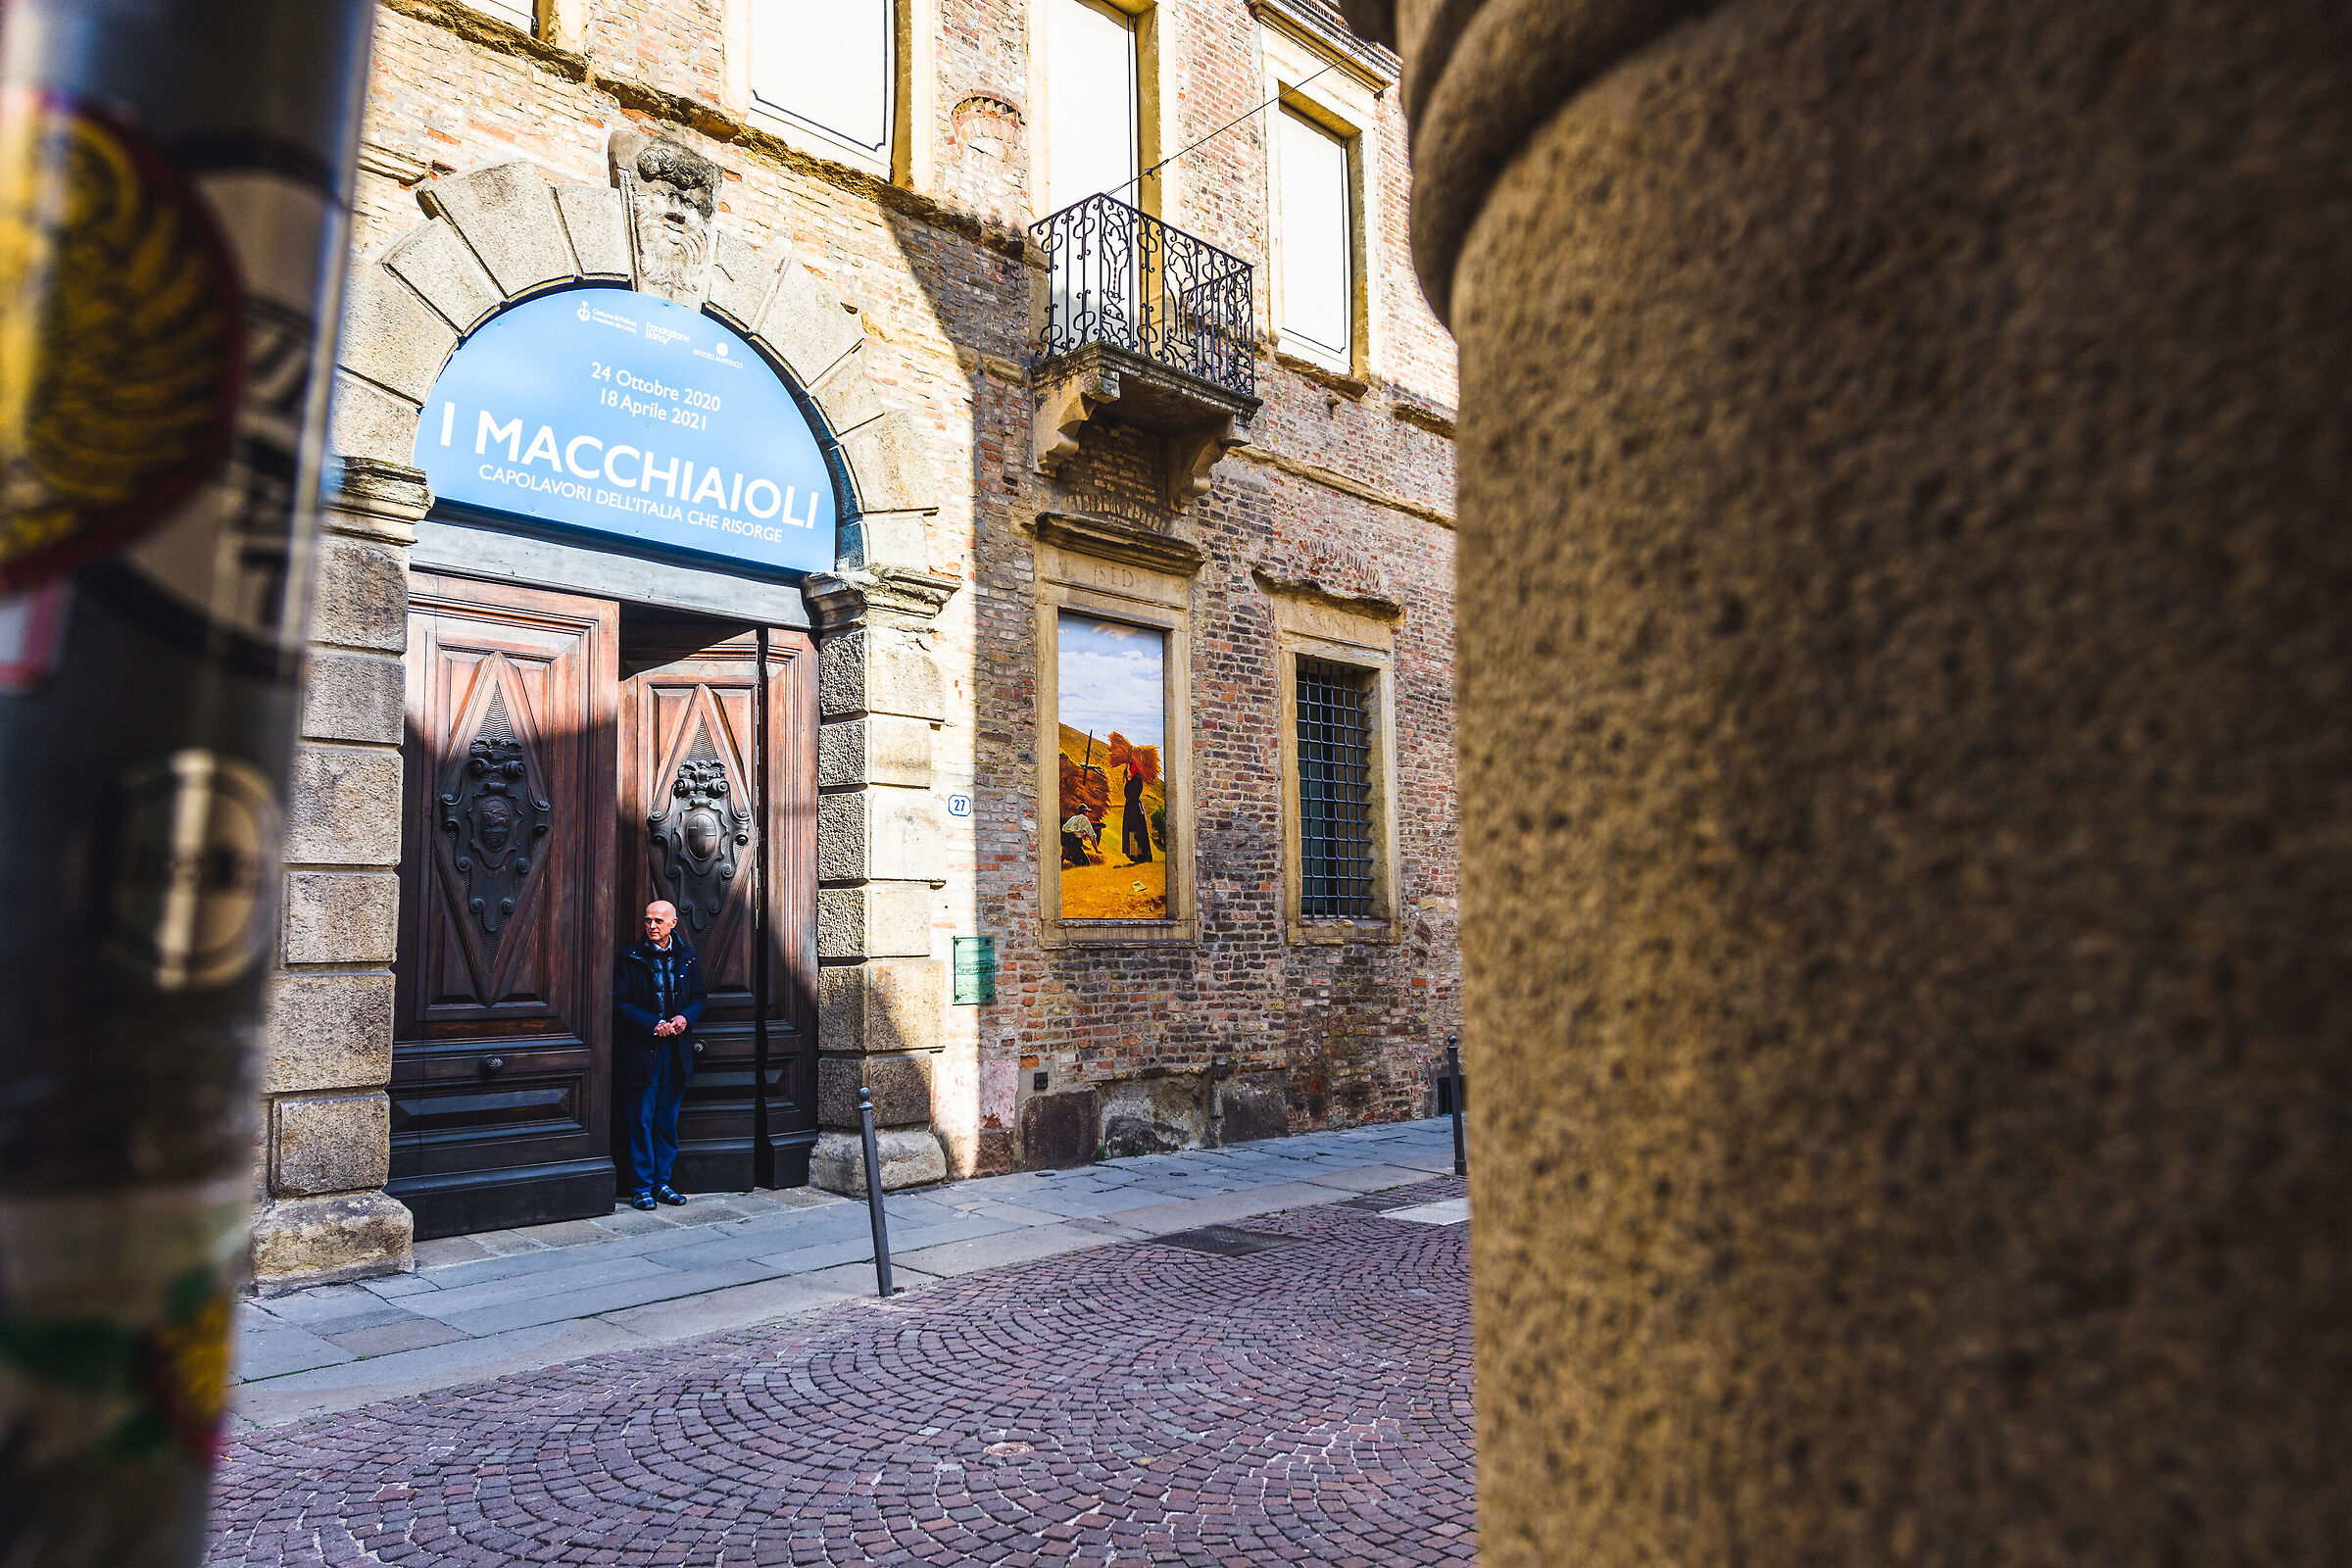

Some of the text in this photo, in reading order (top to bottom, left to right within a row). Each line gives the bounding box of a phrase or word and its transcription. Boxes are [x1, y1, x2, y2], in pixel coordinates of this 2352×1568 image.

[591, 362, 721, 413] 24 Ottobre 2020
[601, 387, 707, 431] 18 Aprile 2021
[440, 401, 819, 530] I MACCHIAIOLI
[478, 464, 783, 543] CAPOLAVORI DELL'ITALIA CHE RISORGE
[955, 799, 965, 811] 27
